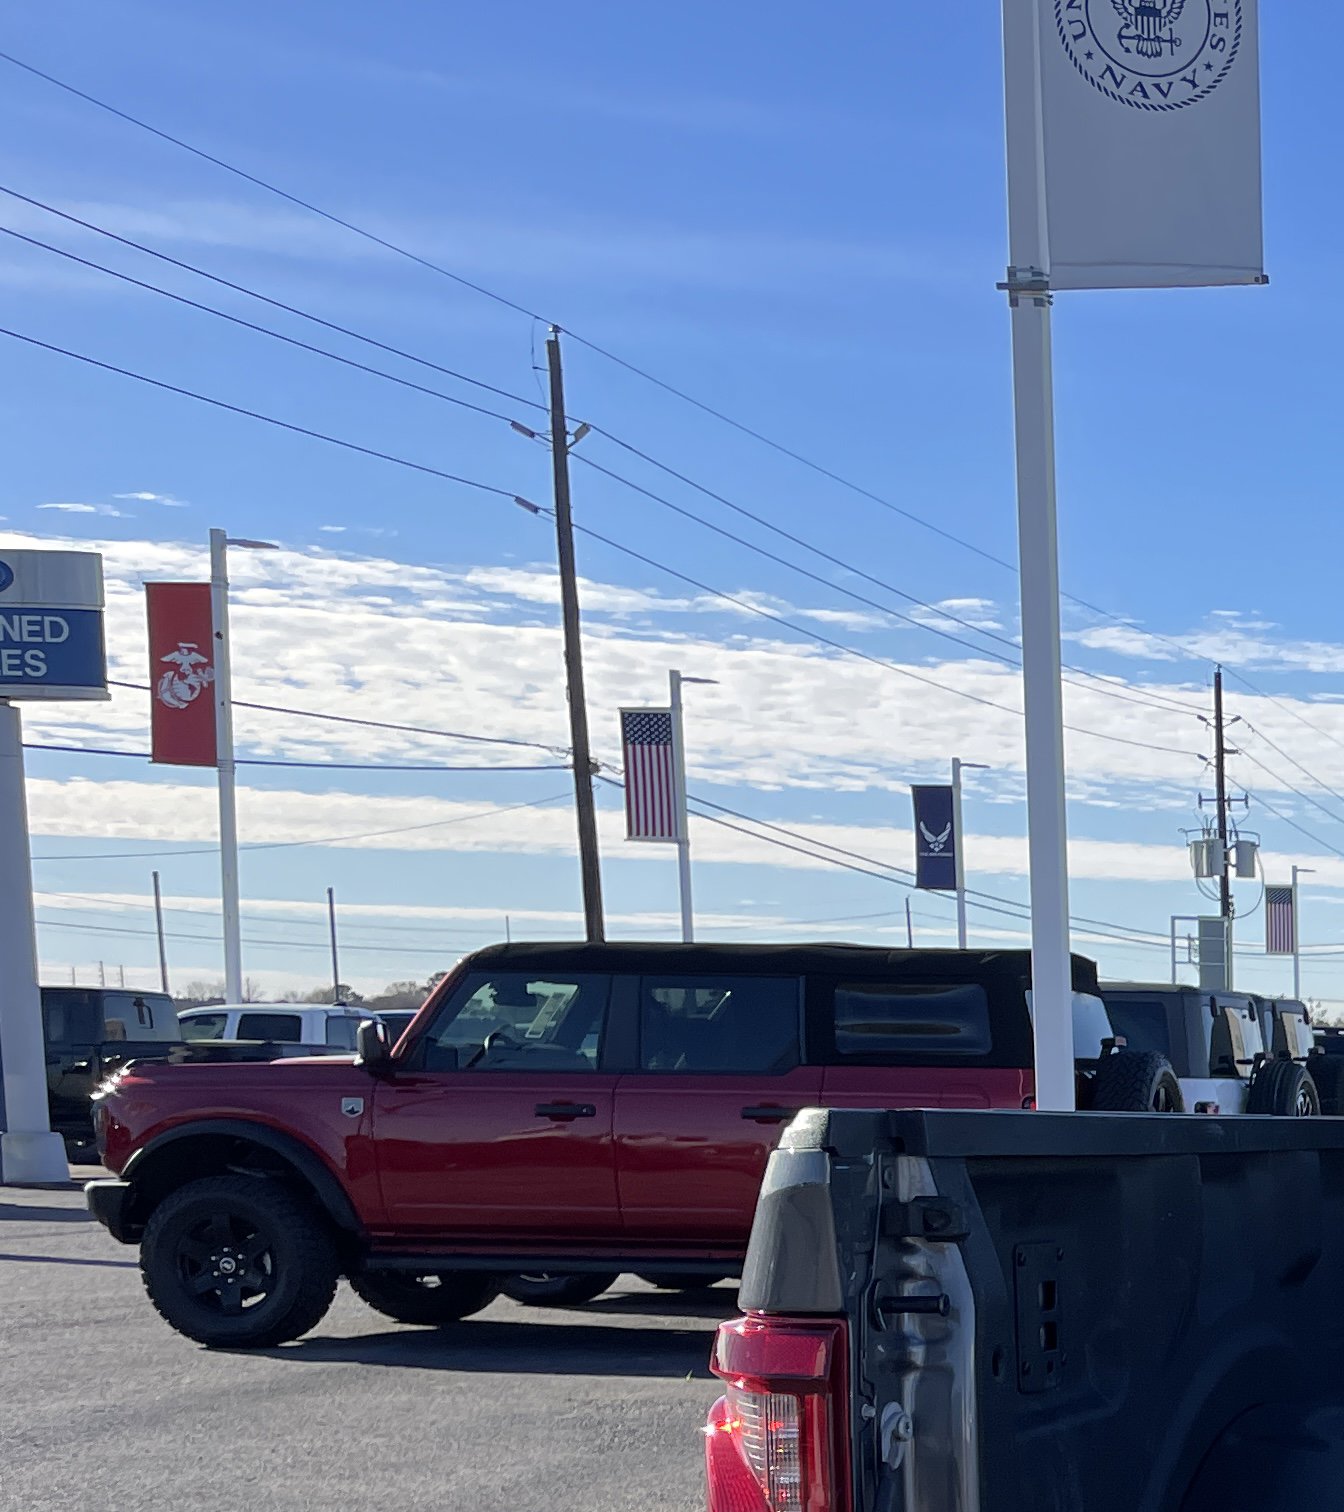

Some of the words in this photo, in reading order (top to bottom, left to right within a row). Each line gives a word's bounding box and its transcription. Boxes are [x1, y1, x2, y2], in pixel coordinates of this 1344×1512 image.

[1099, 64, 1200, 100] NAVY
[0, 615, 69, 643] NED
[1, 649, 48, 677] ES
